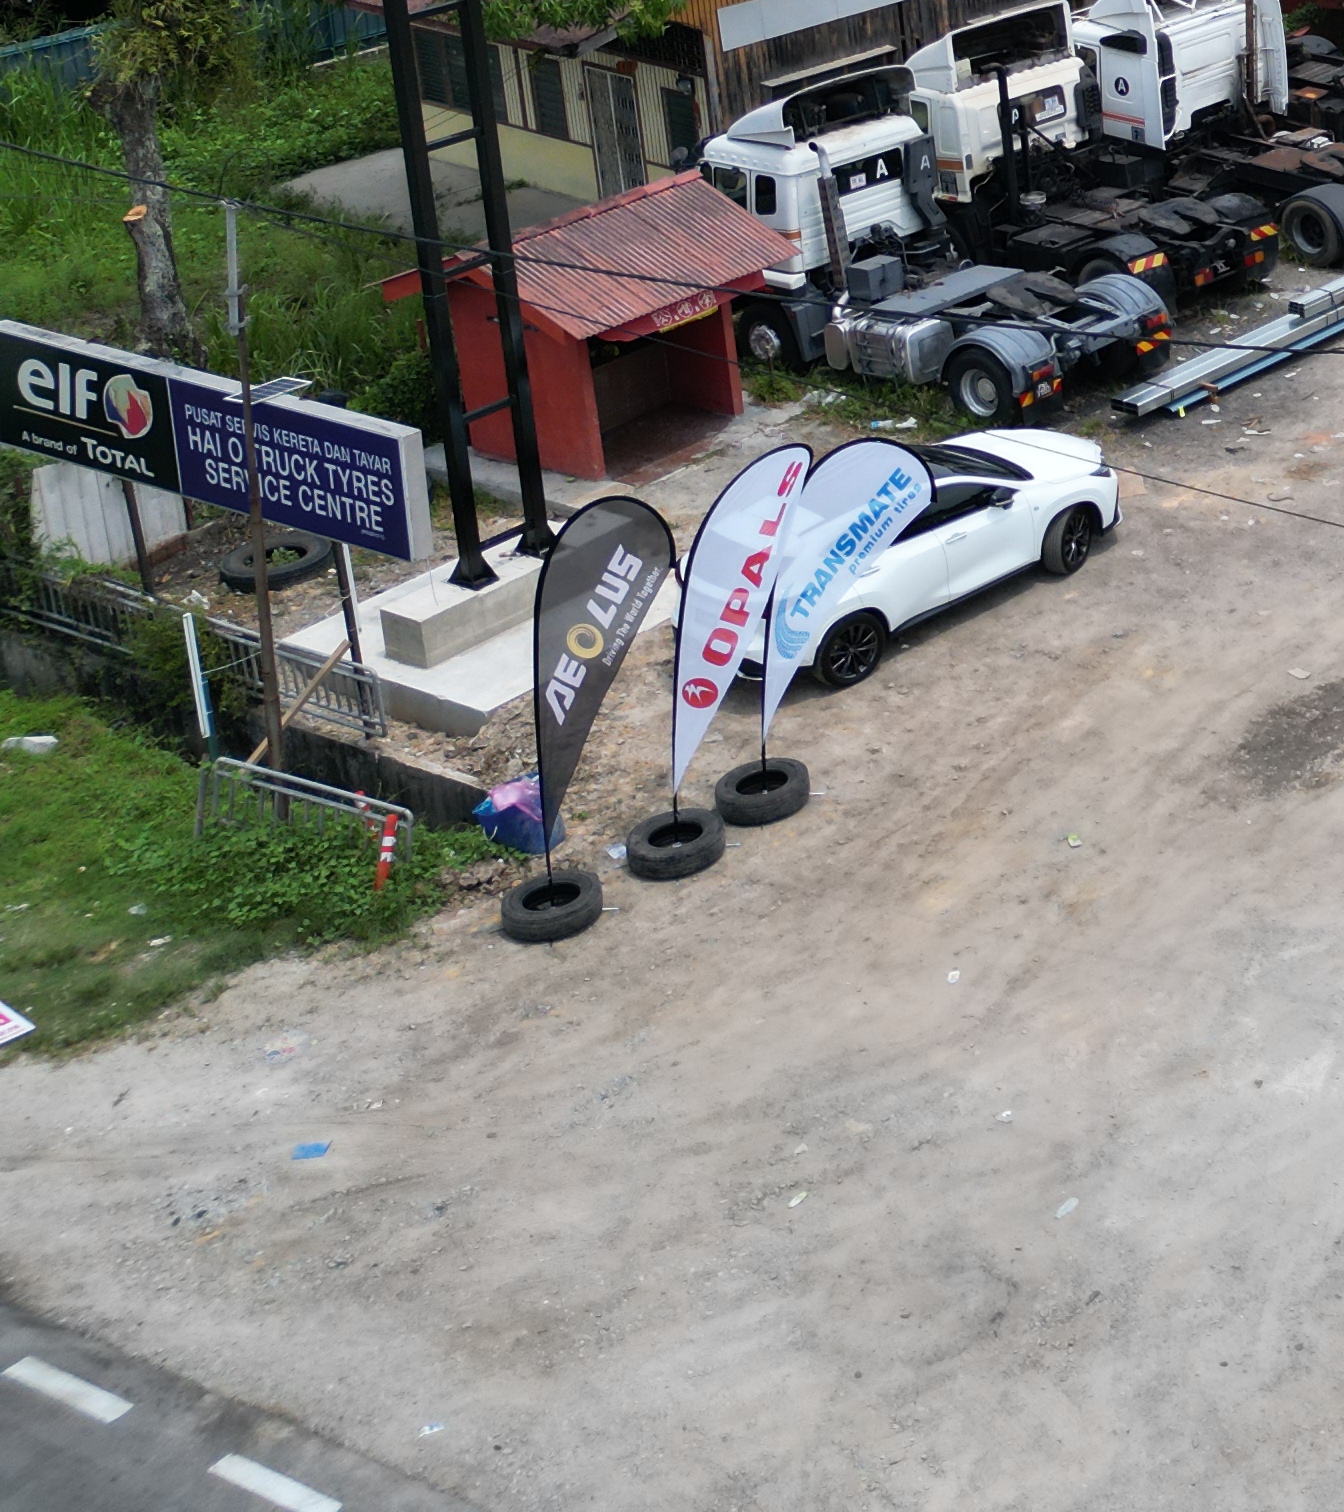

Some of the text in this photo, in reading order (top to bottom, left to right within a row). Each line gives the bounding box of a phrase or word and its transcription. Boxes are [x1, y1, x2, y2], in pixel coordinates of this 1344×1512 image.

[1117, 79, 1127, 93] A
[876, 158, 889, 178] A
[920, 154, 931, 170] A
[18, 359, 98, 420] elf
[22, 431, 155, 477] A brand of TOTAL
[184, 404, 392, 475] PUSAT SEIS KERETA DAN TAYAR
[187, 426, 221, 458] HAI
[228, 437, 243, 463] O
[324, 462, 395, 506] TYRES
[299, 486, 384, 532] CENTRE
[790, 467, 912, 618] TRANSMATE
[849, 483, 922, 575] premium tires
[702, 460, 803, 667] OPALS
[545, 544, 643, 726] AEOLUS
[602, 638, 624, 667] Driving
[616, 622, 631, 638] The
[624, 599, 643, 623] World
